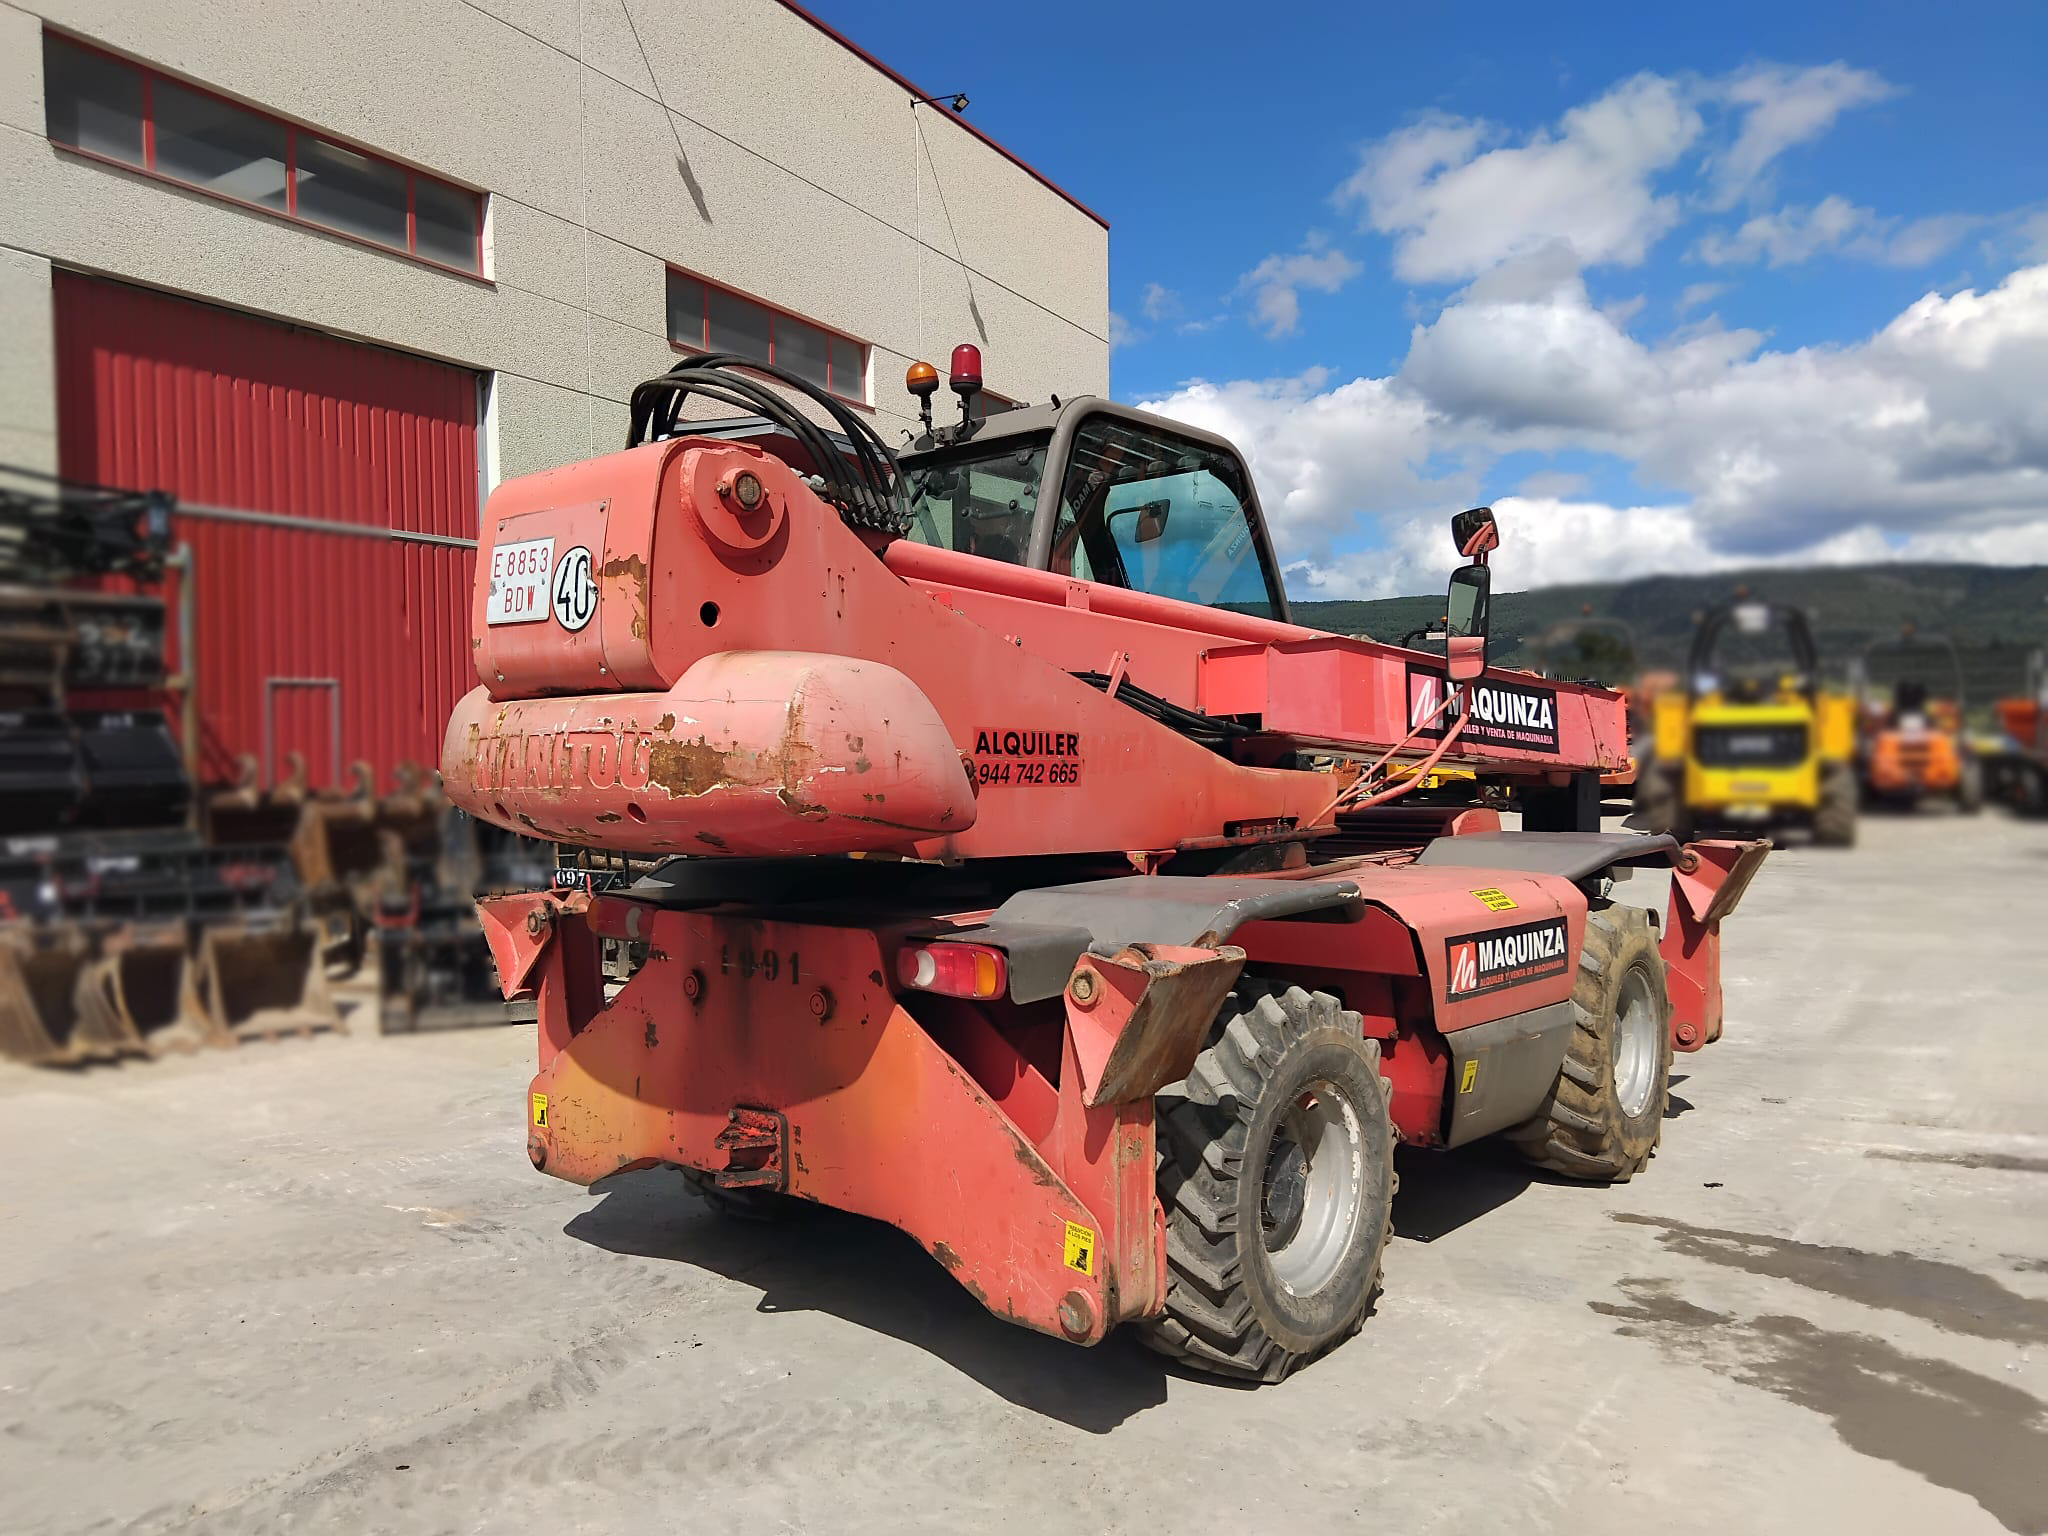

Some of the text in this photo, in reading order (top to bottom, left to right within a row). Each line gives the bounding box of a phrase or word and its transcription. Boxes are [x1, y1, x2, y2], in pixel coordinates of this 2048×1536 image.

[504, 585, 535, 613] BDW
[557, 555, 589, 621] 40
[975, 731, 1079, 757] ALQUILER
[1486, 727, 1506, 739] VENTA
[1507, 730, 1515, 740] DE
[1515, 731, 1554, 745] MAQUINARIA
[979, 762, 1078, 785] 944 742 665
[1478, 926, 1565, 973] MAQUINZA
